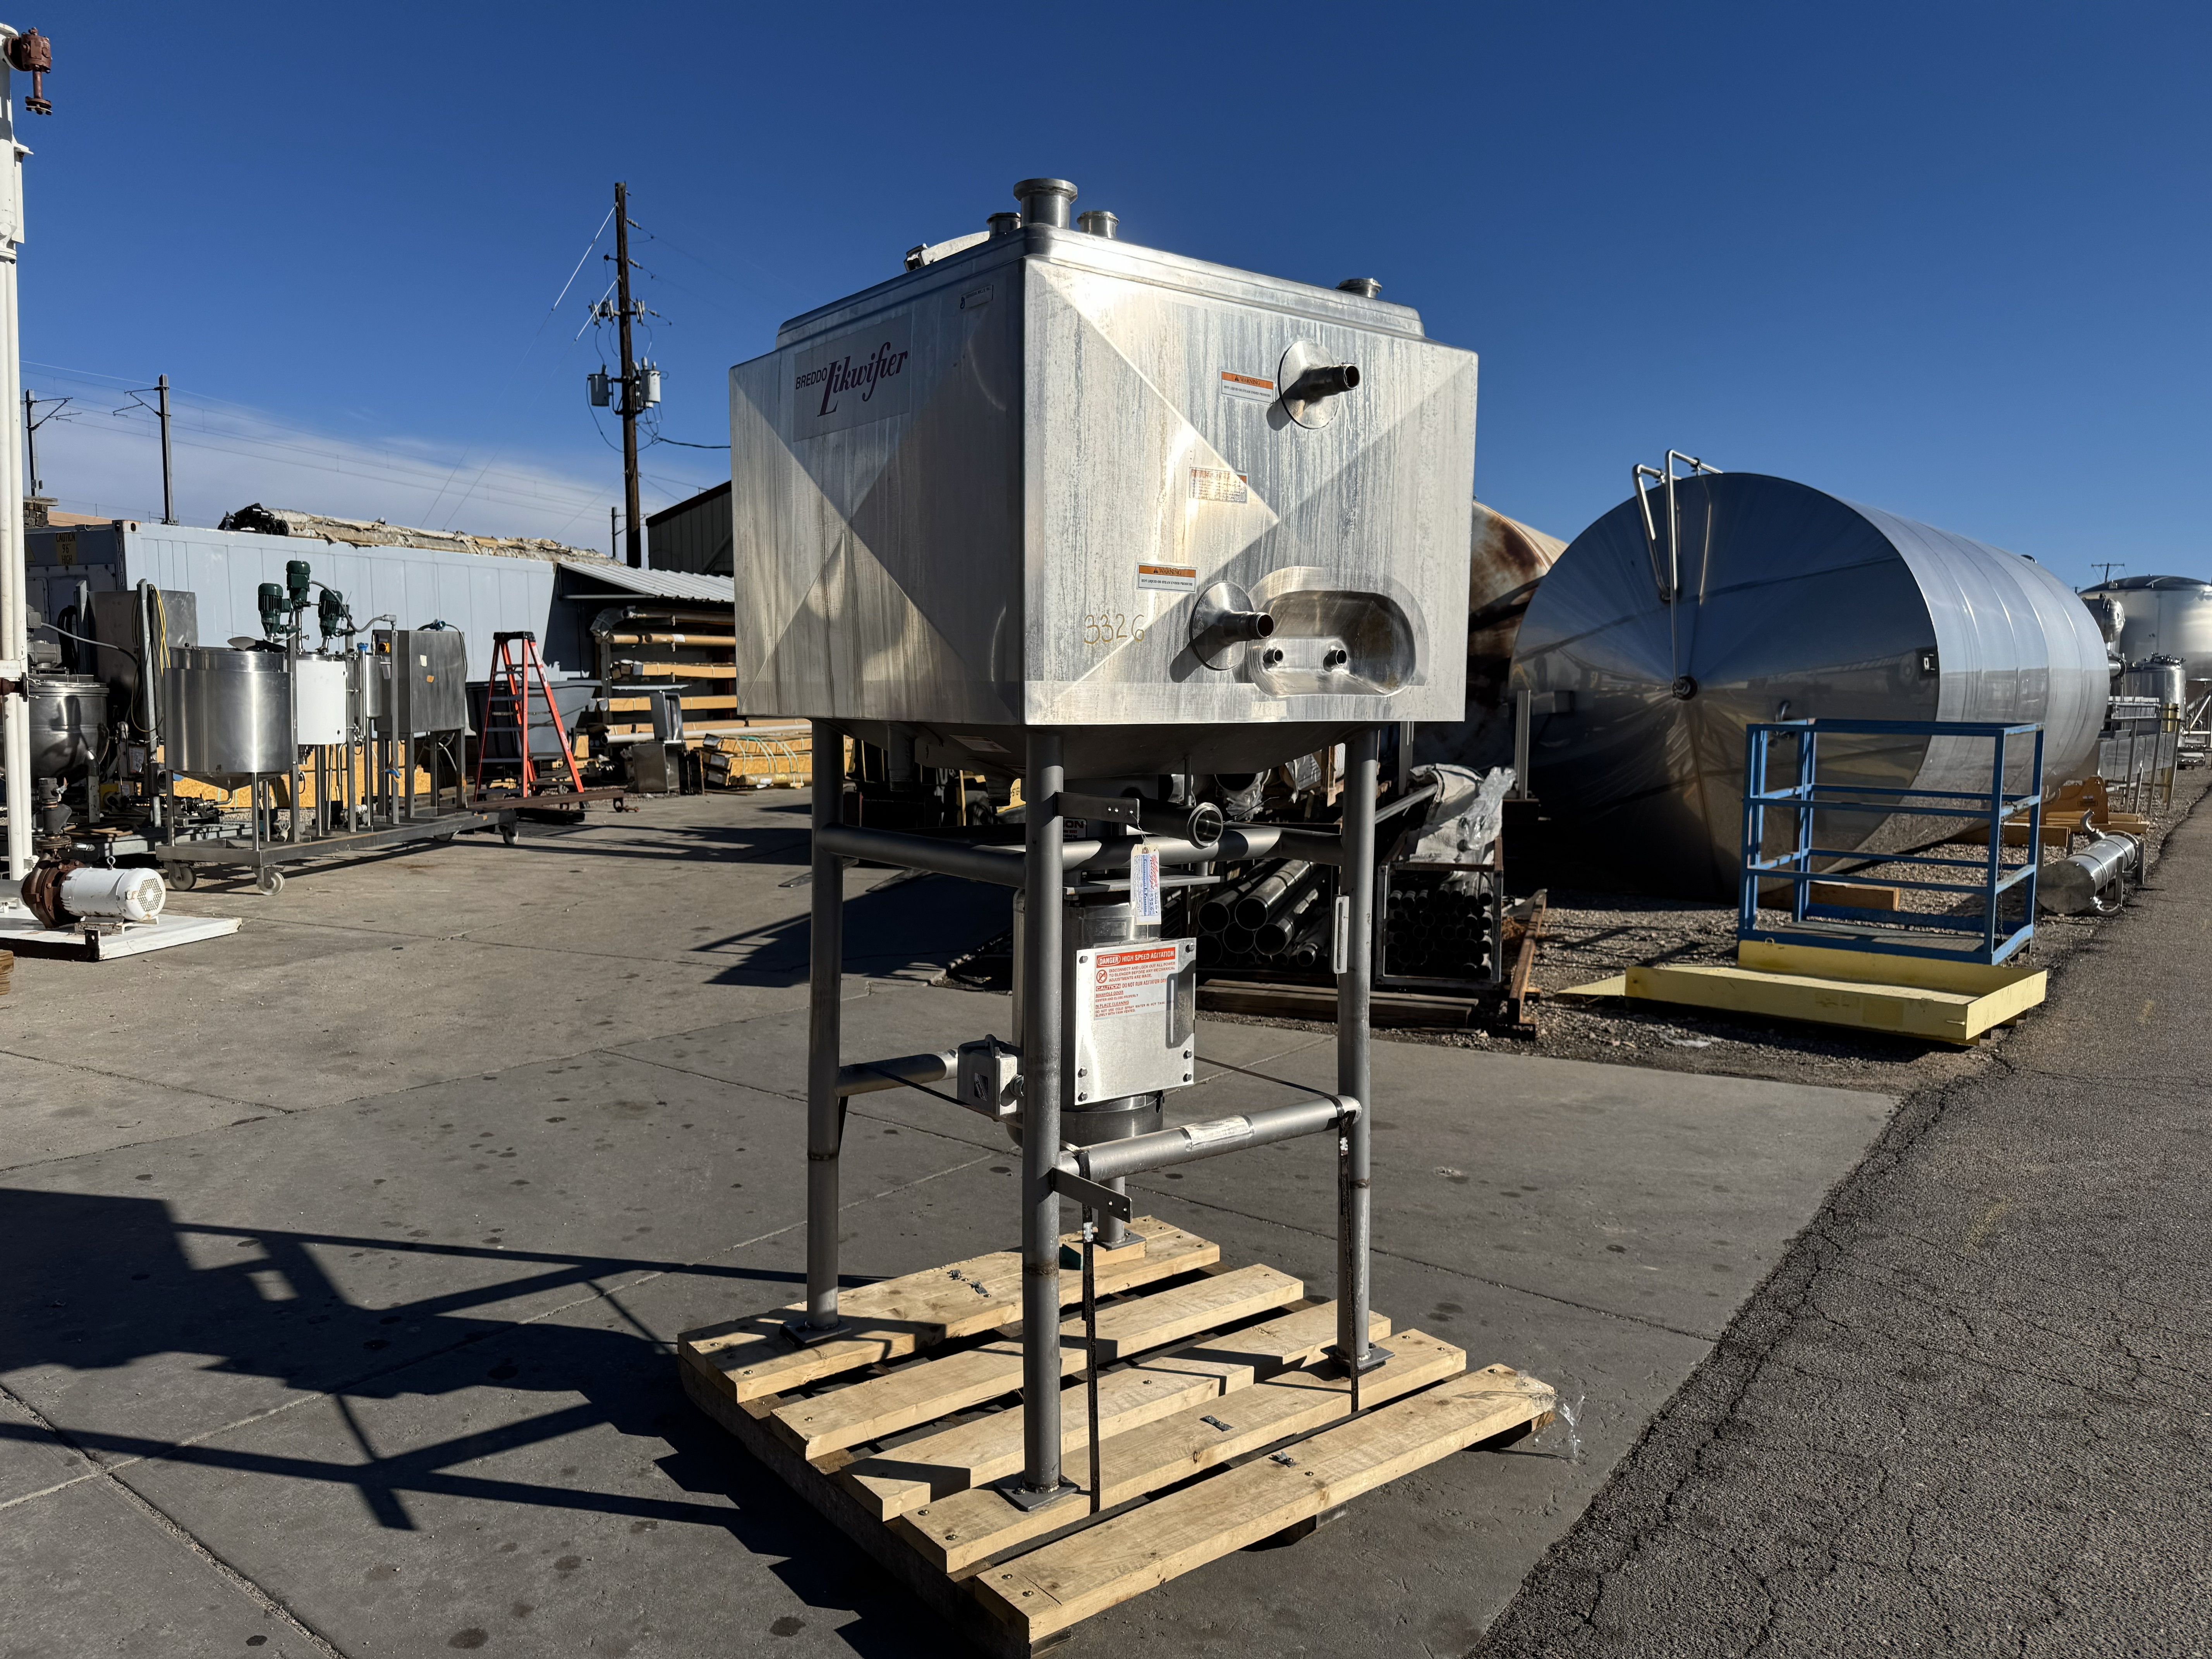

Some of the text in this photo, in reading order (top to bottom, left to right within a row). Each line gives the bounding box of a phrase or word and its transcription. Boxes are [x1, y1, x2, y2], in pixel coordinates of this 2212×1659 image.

[795, 342, 908, 417] BREDDO Likwifier
[1240, 377, 1260, 385] WARNING
[56, 532, 75, 542] CAUTION
[62, 555, 72, 564] HIGH
[1084, 613, 1145, 644] 3326
[1099, 957, 1118, 965] DANGER
[1151, 950, 1174, 959] AGITATION
